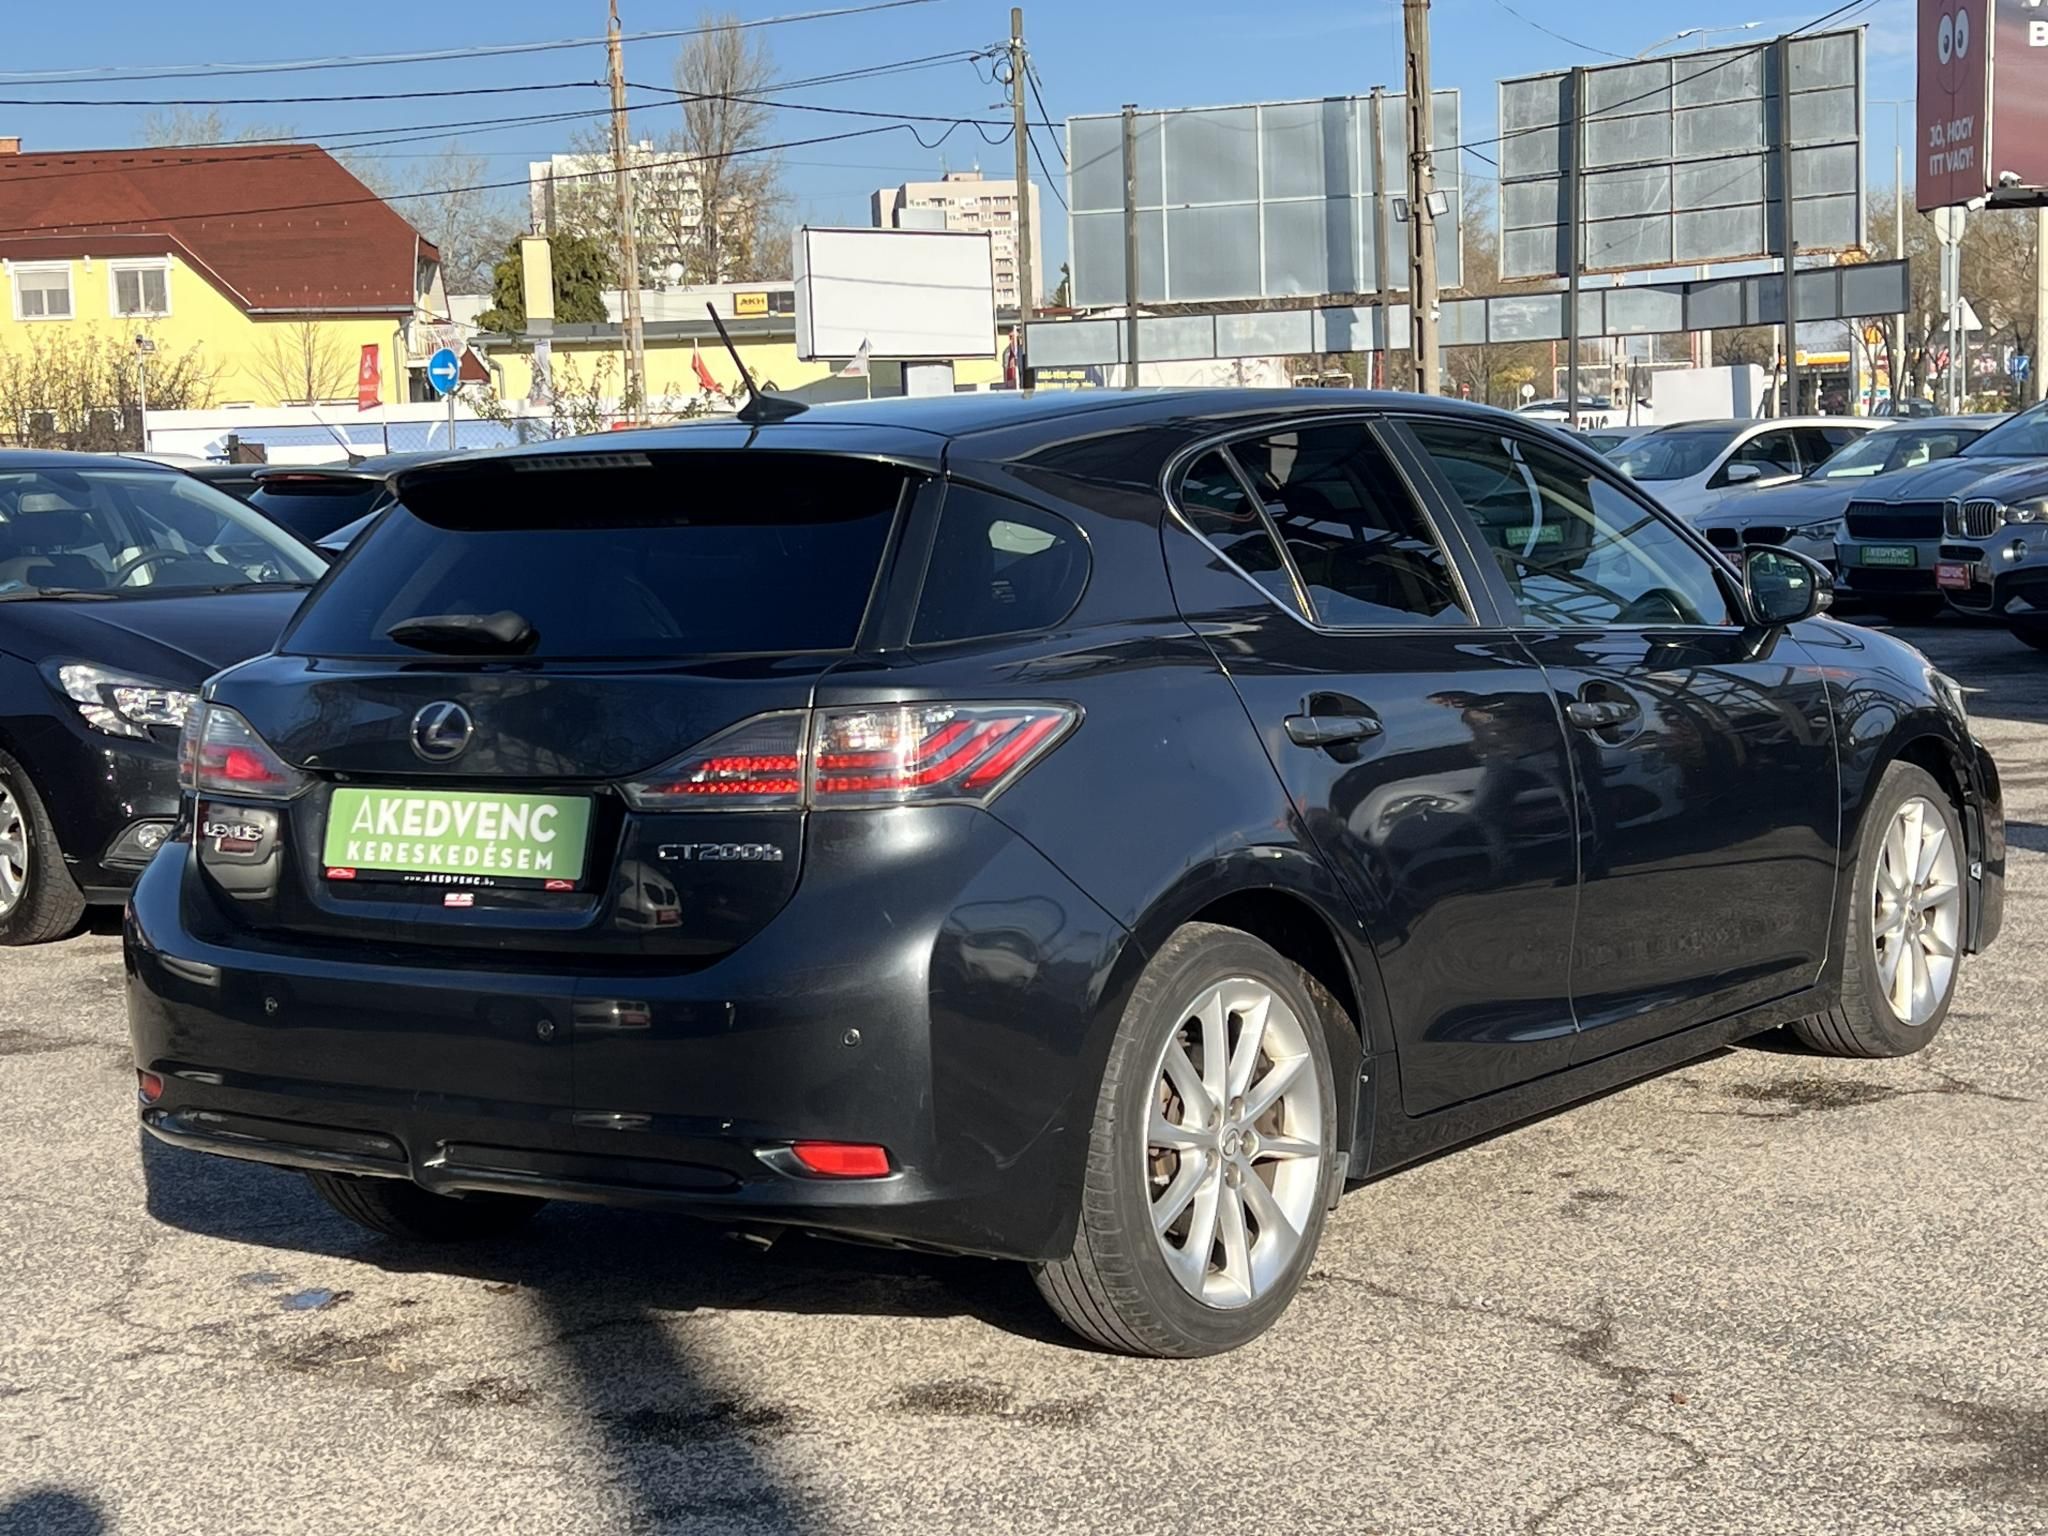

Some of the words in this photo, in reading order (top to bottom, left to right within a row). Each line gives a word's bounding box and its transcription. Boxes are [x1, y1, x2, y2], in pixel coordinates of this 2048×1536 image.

[1947, 115, 1974, 143] HOGY
[1929, 153, 1945, 176] ITT
[202, 821, 265, 841] LEXUS
[350, 794, 560, 843] AKEDVENC
[346, 840, 555, 872] KERESKEDÉSEM
